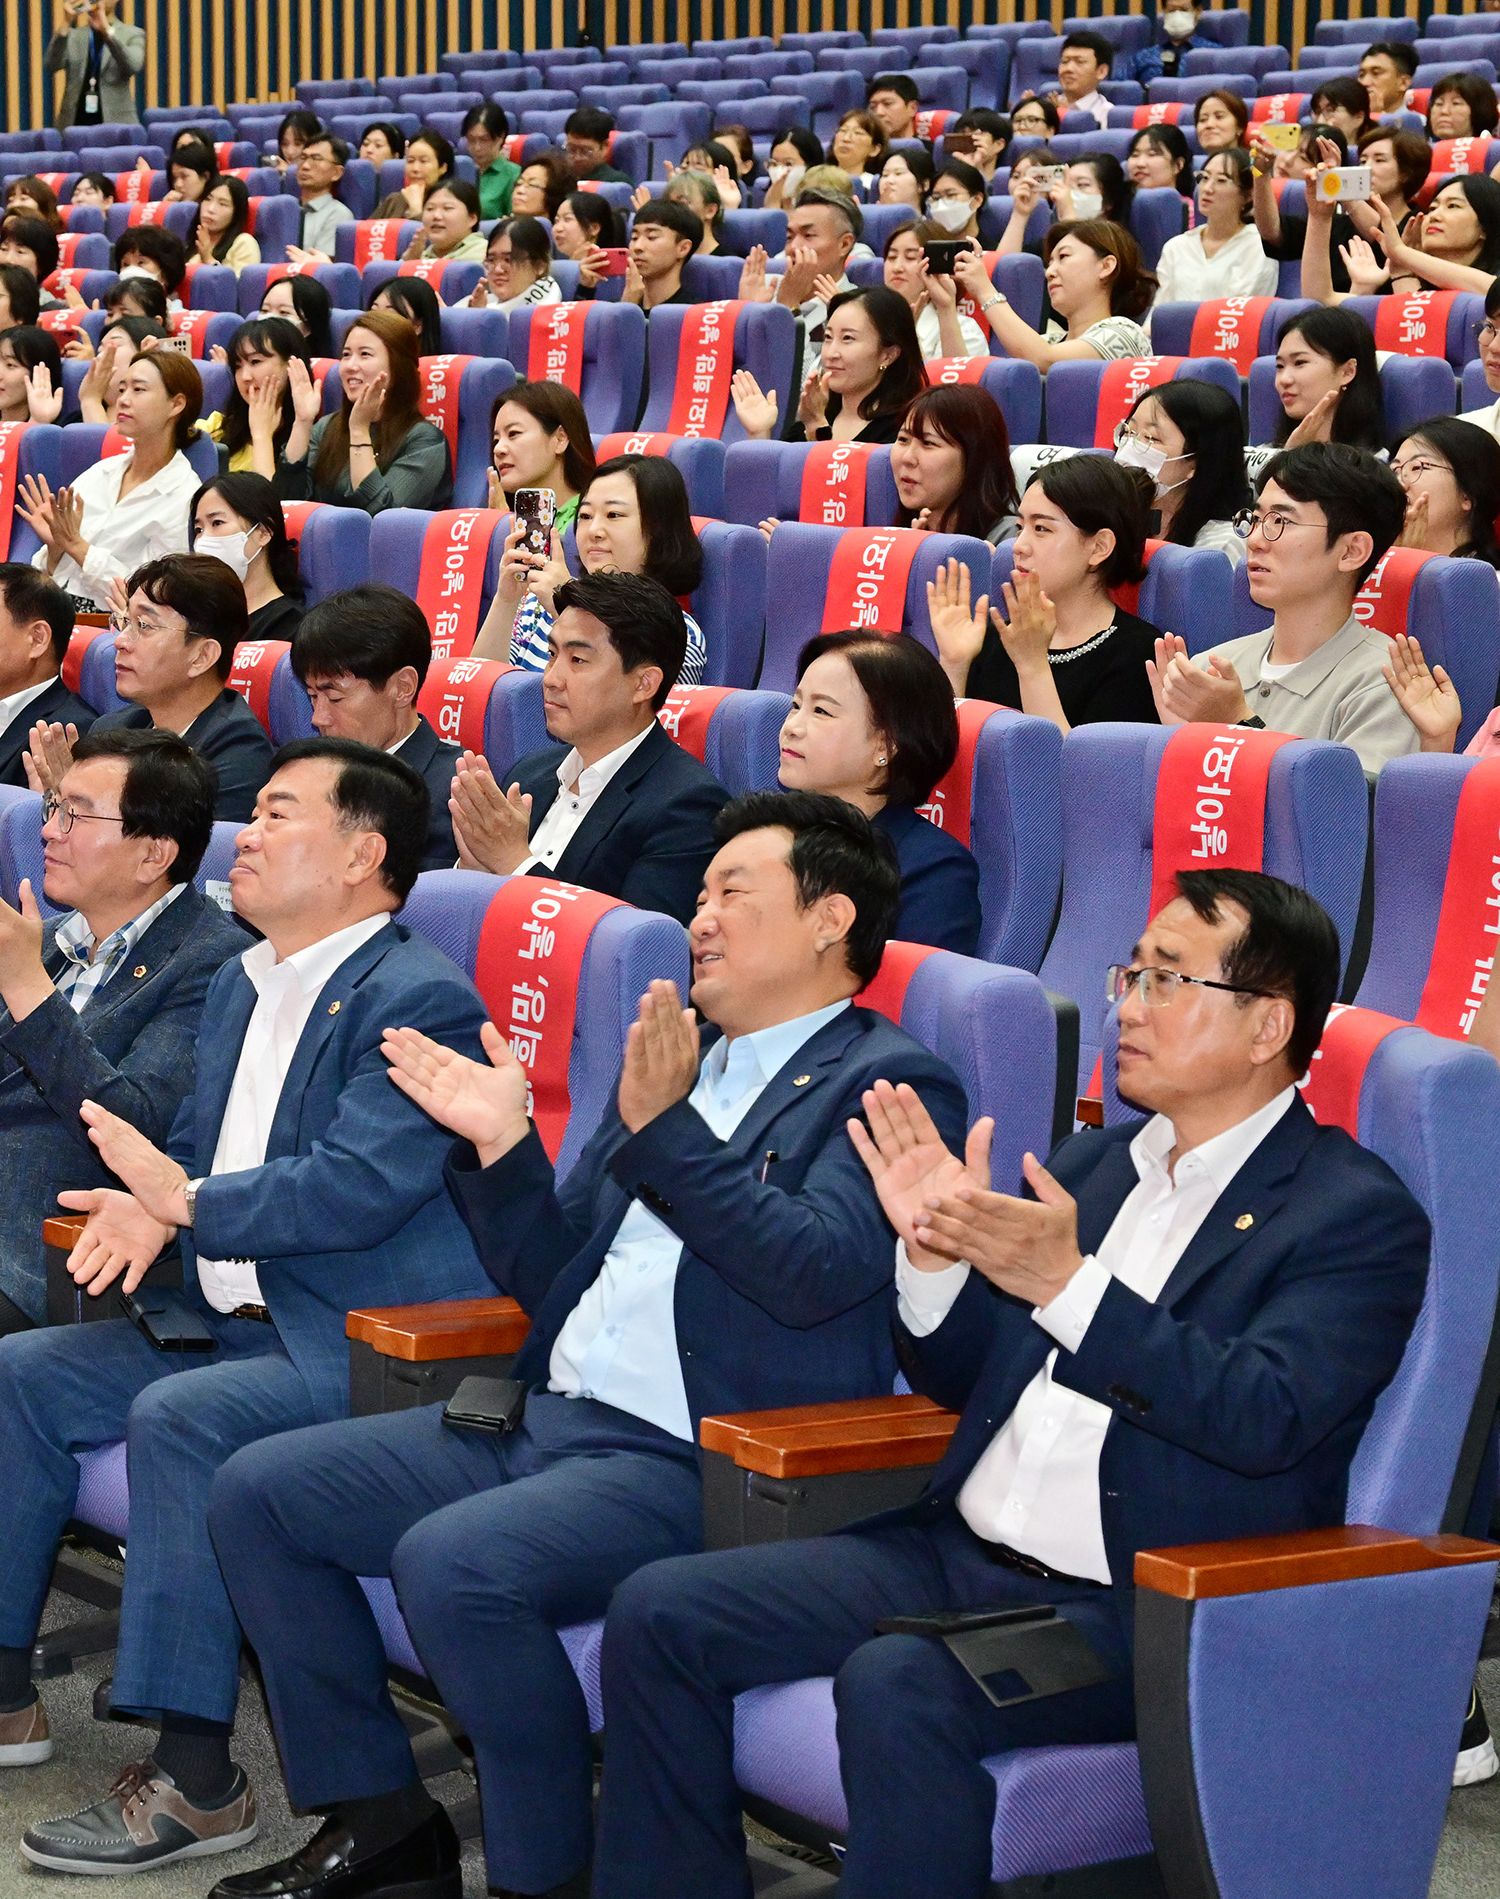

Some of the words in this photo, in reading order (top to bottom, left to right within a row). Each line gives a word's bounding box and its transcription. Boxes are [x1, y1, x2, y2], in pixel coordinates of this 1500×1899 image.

[698, 298, 732, 345] 낳아
[692, 349, 718, 394] 희망,
[826, 440, 866, 486] 낳아
[440, 511, 482, 598] 낳아요!
[849, 535, 897, 627] 낳아요!
[431, 601, 461, 660] 희망,
[1190, 734, 1246, 858] 낳아요!
[508, 974, 551, 1068] 희망,
